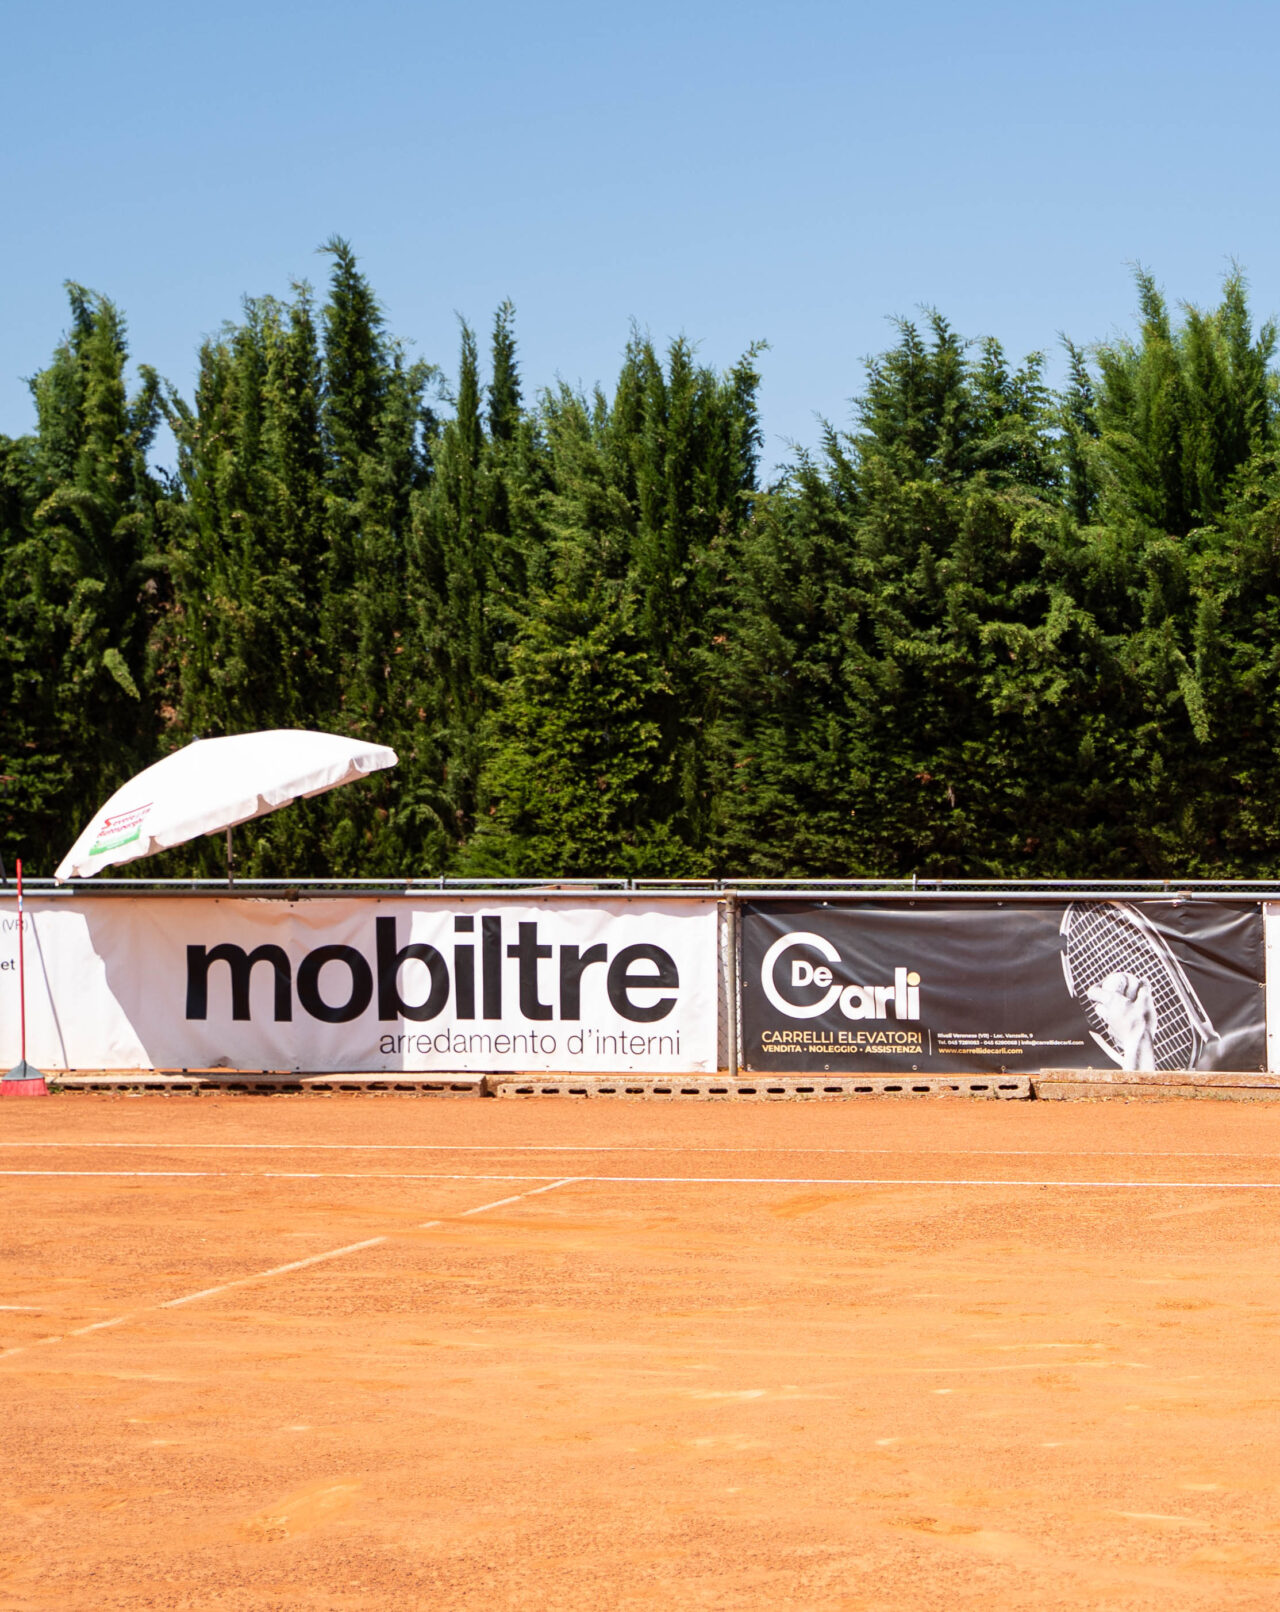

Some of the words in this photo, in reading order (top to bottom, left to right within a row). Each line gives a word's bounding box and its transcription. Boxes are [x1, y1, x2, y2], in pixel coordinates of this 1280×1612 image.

[186, 915, 680, 1024] mobiltre
[761, 931, 921, 1020] Carli
[792, 960, 833, 987] De
[379, 1028, 557, 1054] arredamento
[761, 1030, 834, 1043] CARRELLI
[838, 1031, 923, 1044] ELEVATORI
[762, 1044, 802, 1053] VENDITA
[809, 1045, 858, 1053] NOLEGGIO
[865, 1045, 923, 1054] ASSISTENZA
[938, 1047, 1023, 1055] www.carrellidecarli.com
